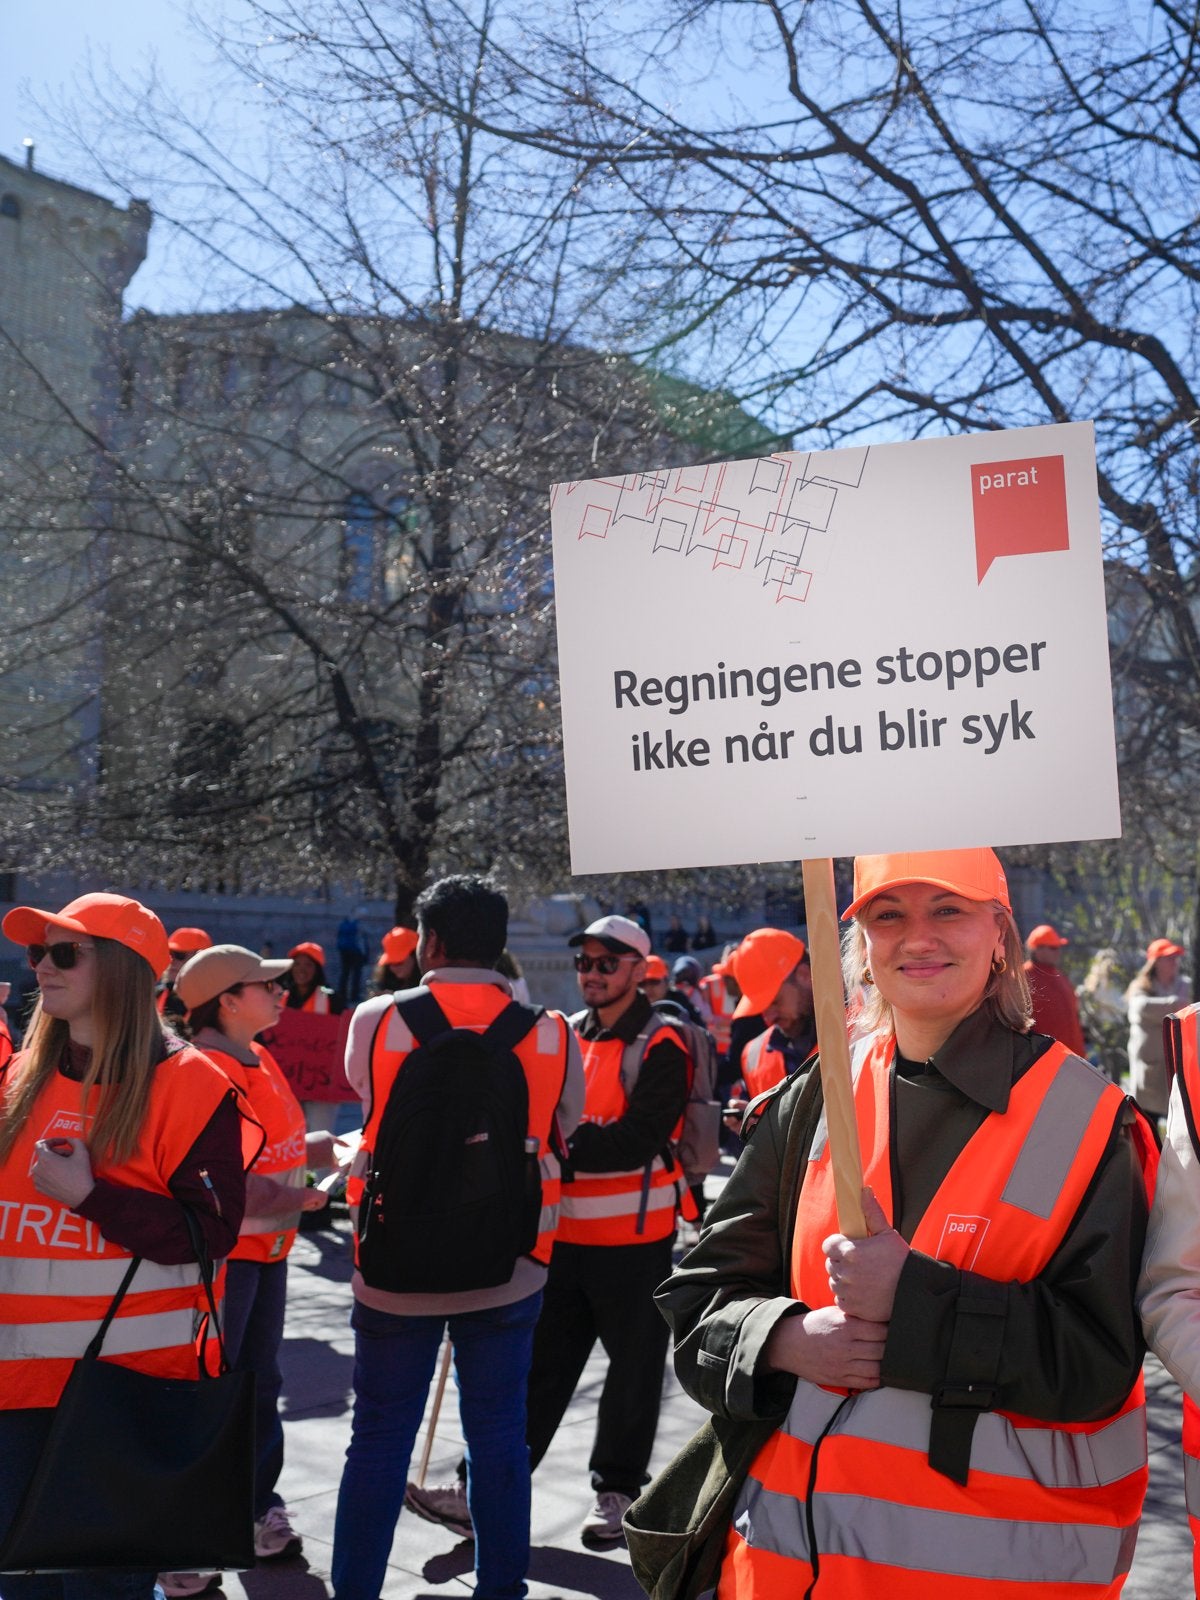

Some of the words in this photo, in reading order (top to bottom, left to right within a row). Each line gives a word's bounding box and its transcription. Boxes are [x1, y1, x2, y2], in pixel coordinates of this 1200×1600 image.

[979, 466, 1039, 495] parat
[614, 659, 861, 714] Regningene
[876, 641, 1047, 690] stopper
[632, 730, 710, 771] ikke
[725, 722, 794, 764] når
[809, 715, 863, 757] du
[879, 708, 947, 751] blir
[962, 699, 1036, 754] syk
[53, 1117, 84, 1131] para
[948, 1222, 977, 1234] para
